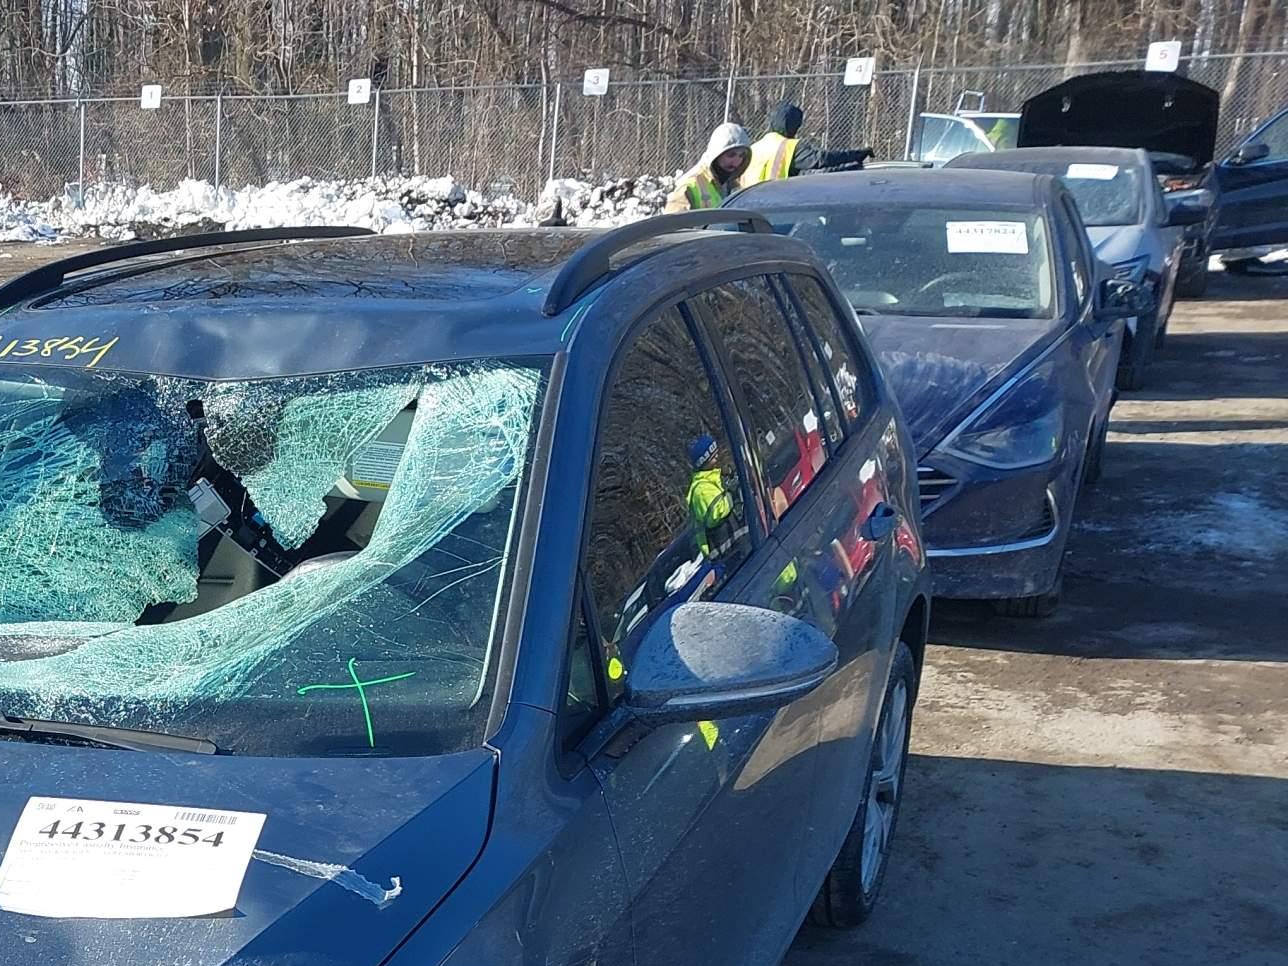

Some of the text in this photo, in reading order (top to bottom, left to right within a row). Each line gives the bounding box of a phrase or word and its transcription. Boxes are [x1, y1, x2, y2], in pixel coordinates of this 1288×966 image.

[1159, 49, 1169, 60] 5
[855, 64, 863, 73] 4
[592, 75, 600, 85] 3
[355, 85, 363, 94] 2
[38, 820, 225, 847] 44313854
